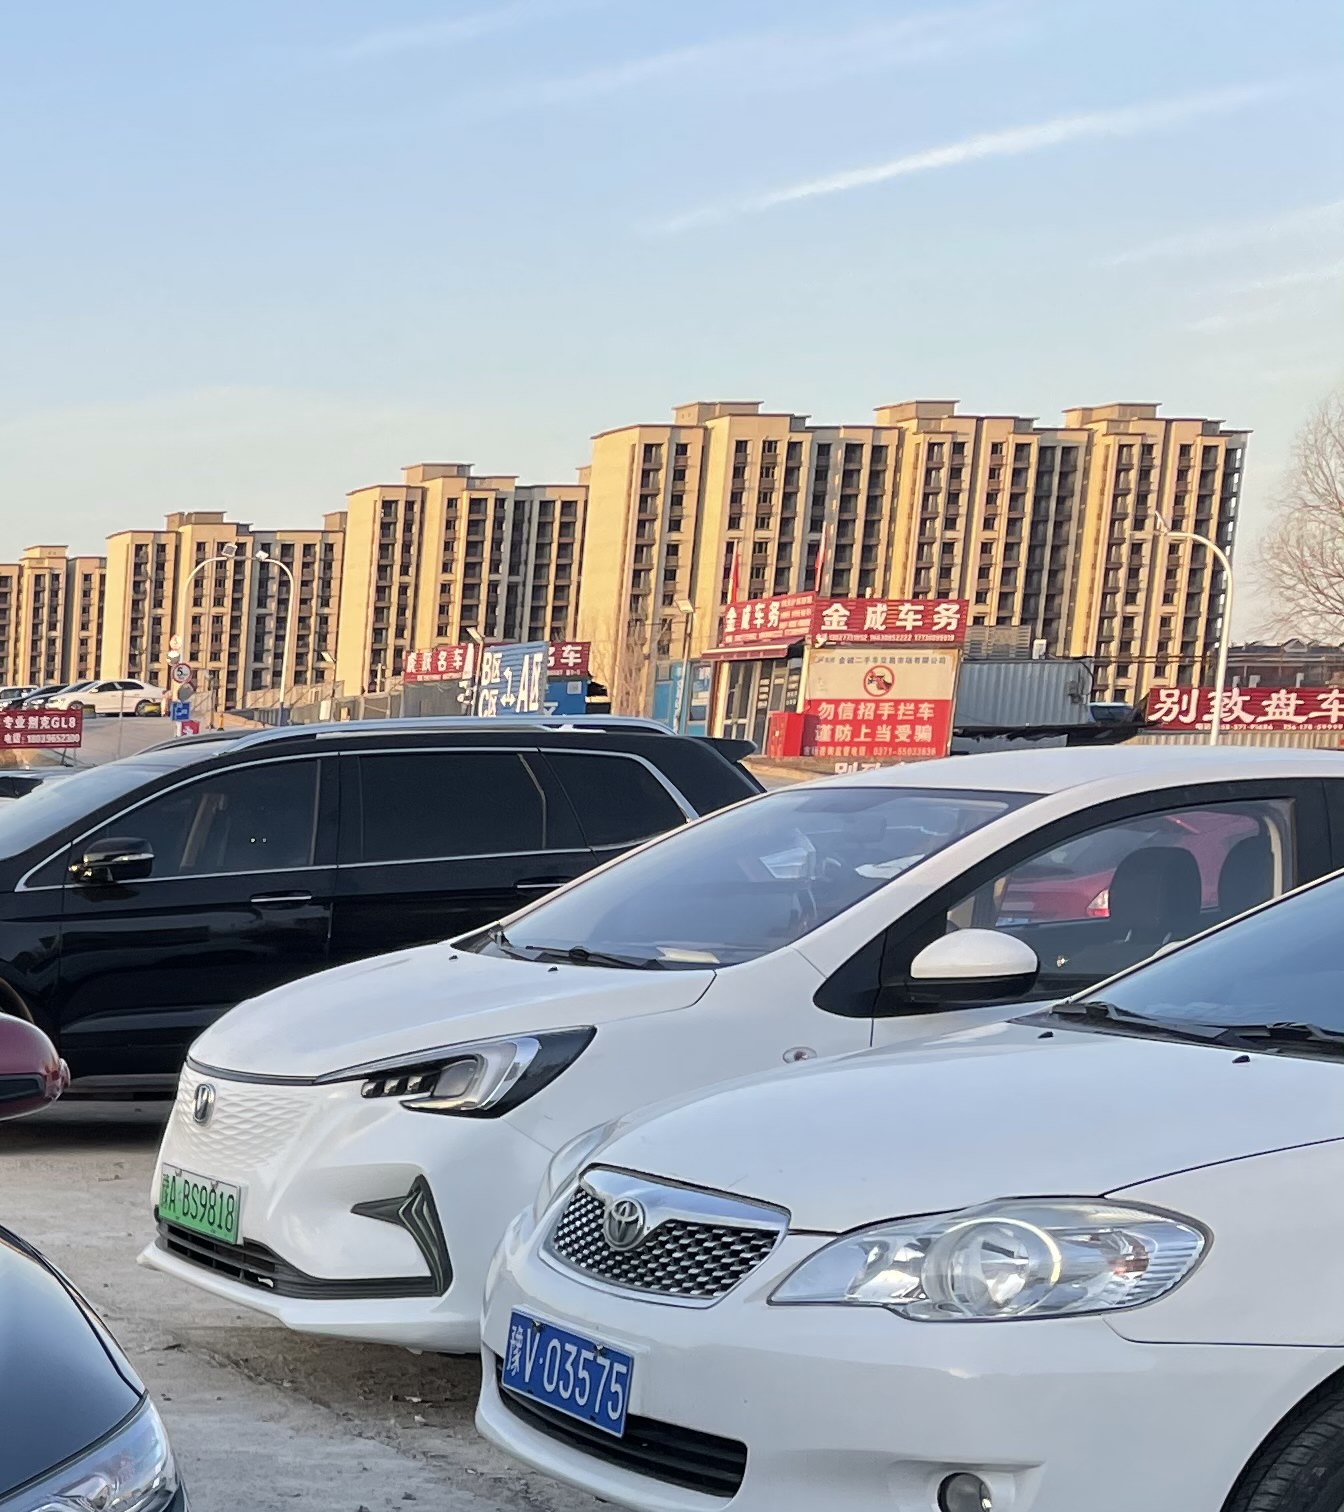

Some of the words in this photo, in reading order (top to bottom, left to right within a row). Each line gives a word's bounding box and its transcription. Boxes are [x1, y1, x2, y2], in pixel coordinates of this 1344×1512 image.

[820, 603, 961, 631] 金成车务
[818, 702, 936, 721] 勿信招手拦车
[815, 724, 933, 742] 谨防上当受骗
